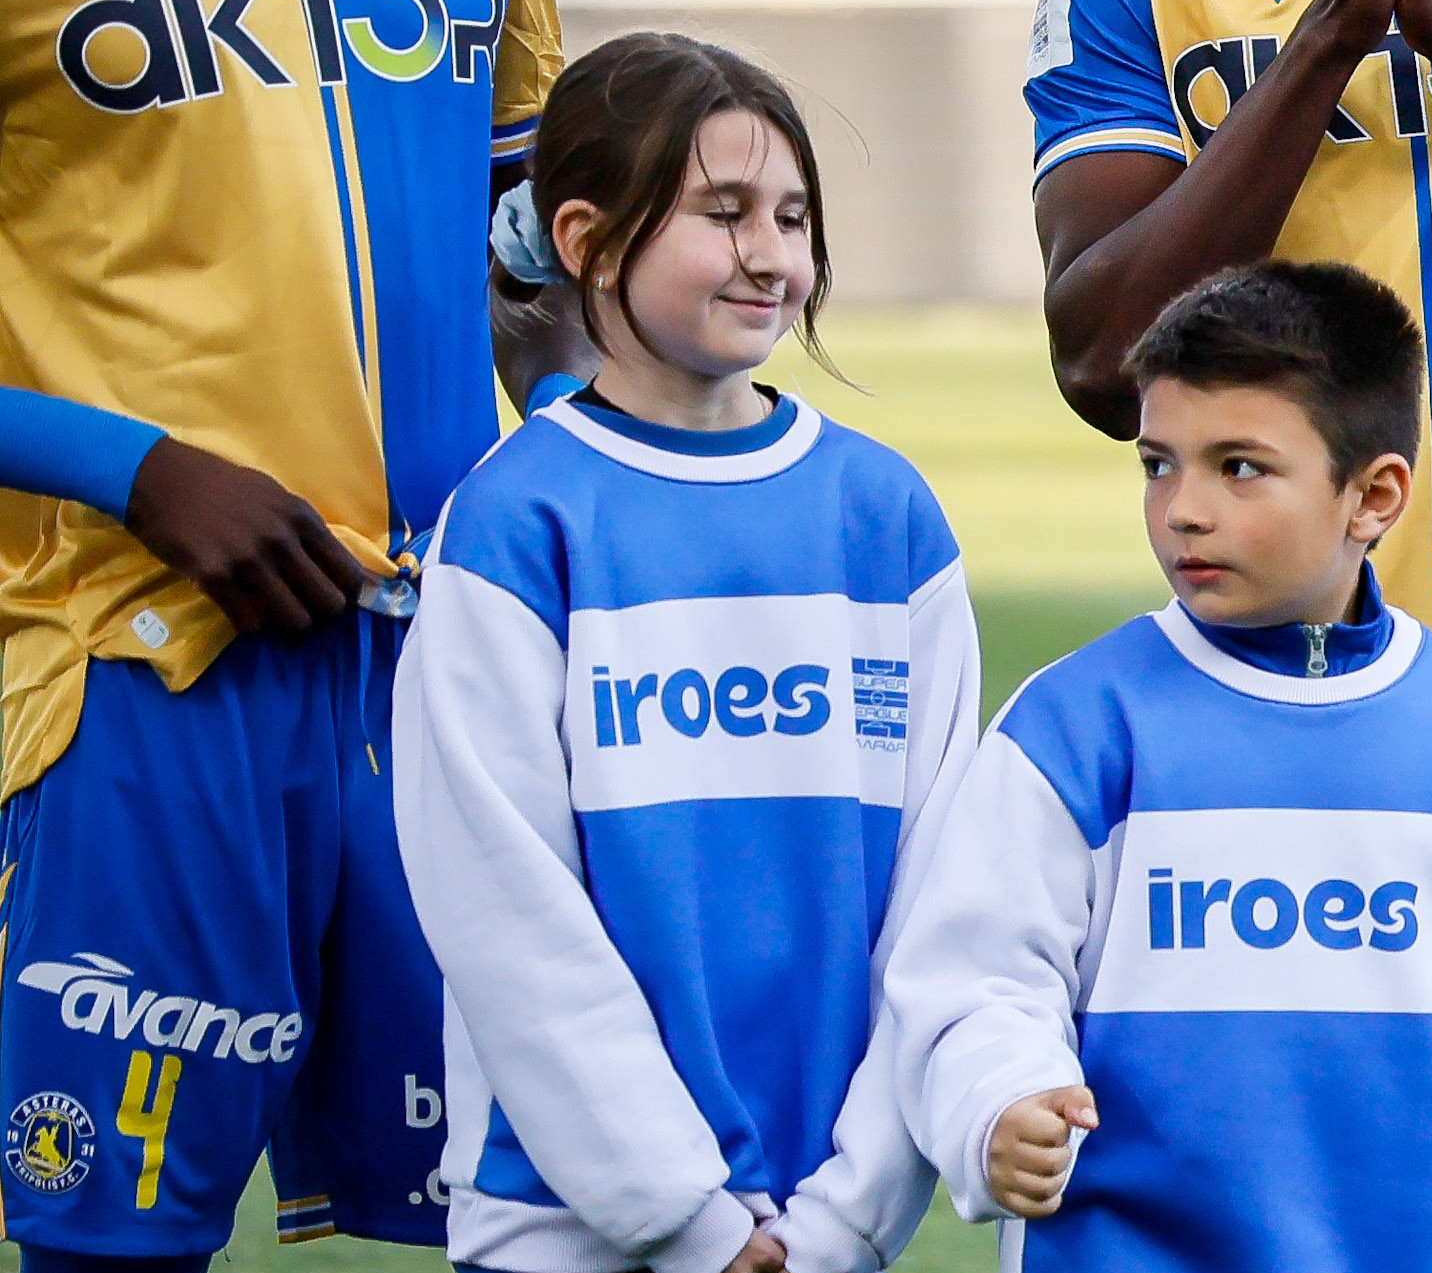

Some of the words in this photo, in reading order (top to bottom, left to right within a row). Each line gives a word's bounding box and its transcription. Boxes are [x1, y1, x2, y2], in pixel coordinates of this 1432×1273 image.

[592, 664, 831, 748] iroes
[1147, 866, 1419, 950] iroes
[60, 977, 302, 1063] avance
[22, 1096, 86, 1127] ASTERAS
[116, 1049, 182, 1210] 4
